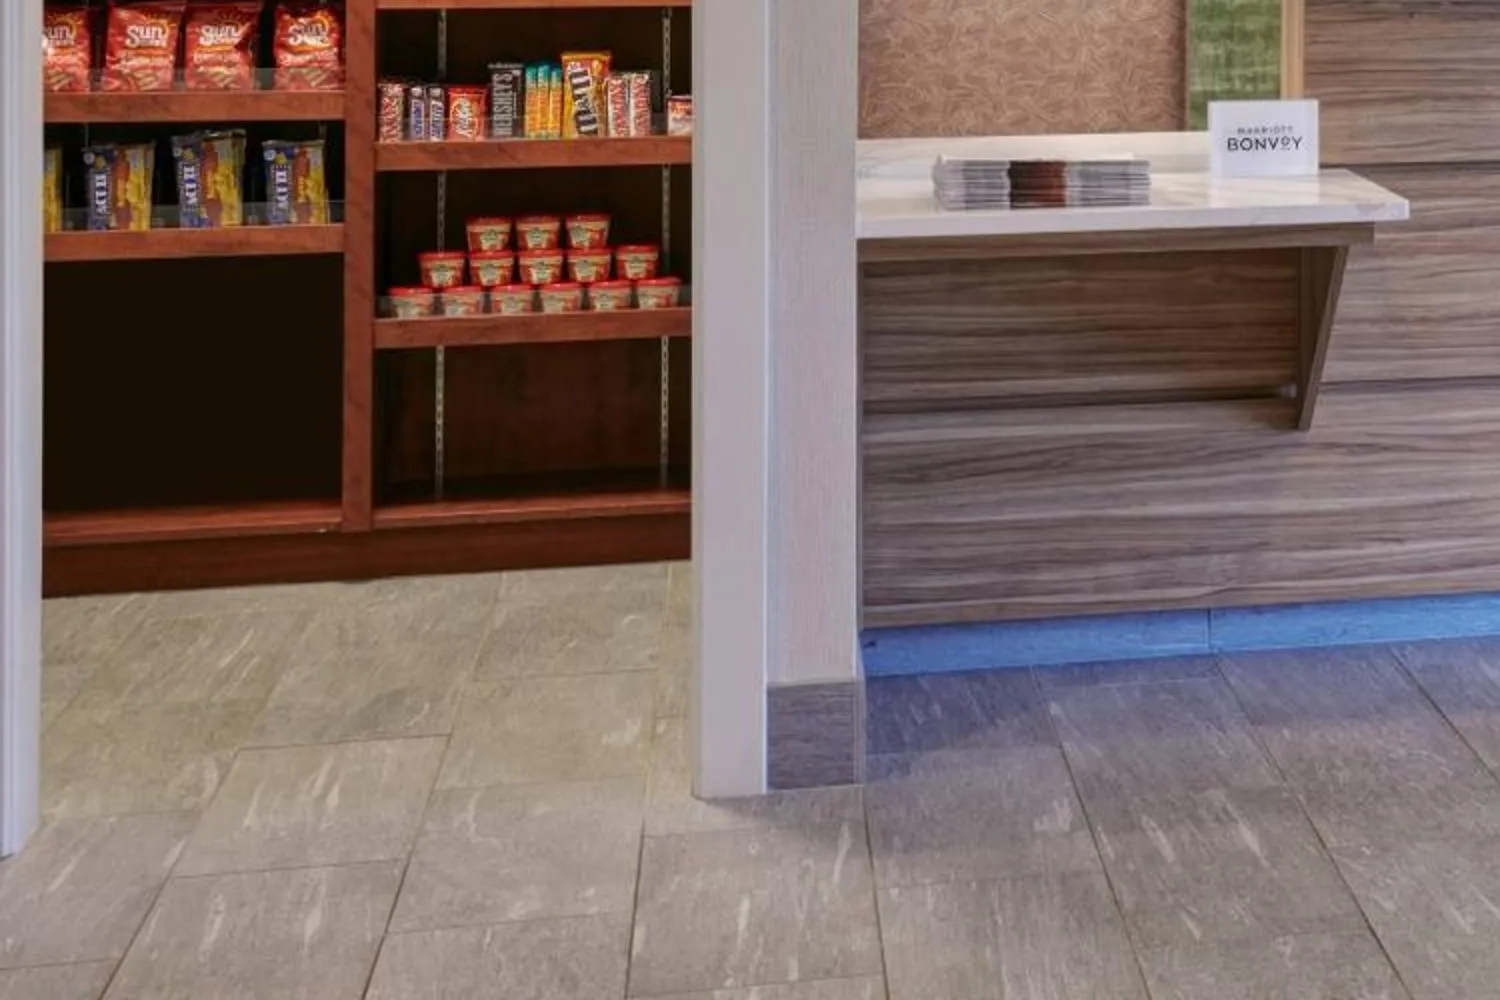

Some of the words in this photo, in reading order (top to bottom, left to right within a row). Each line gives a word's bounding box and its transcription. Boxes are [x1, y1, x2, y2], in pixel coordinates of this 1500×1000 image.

[125, 23, 164, 48] Sun
[493, 72, 513, 137] HERSHEY'S
[1227, 135, 1303, 151] BONVOY
